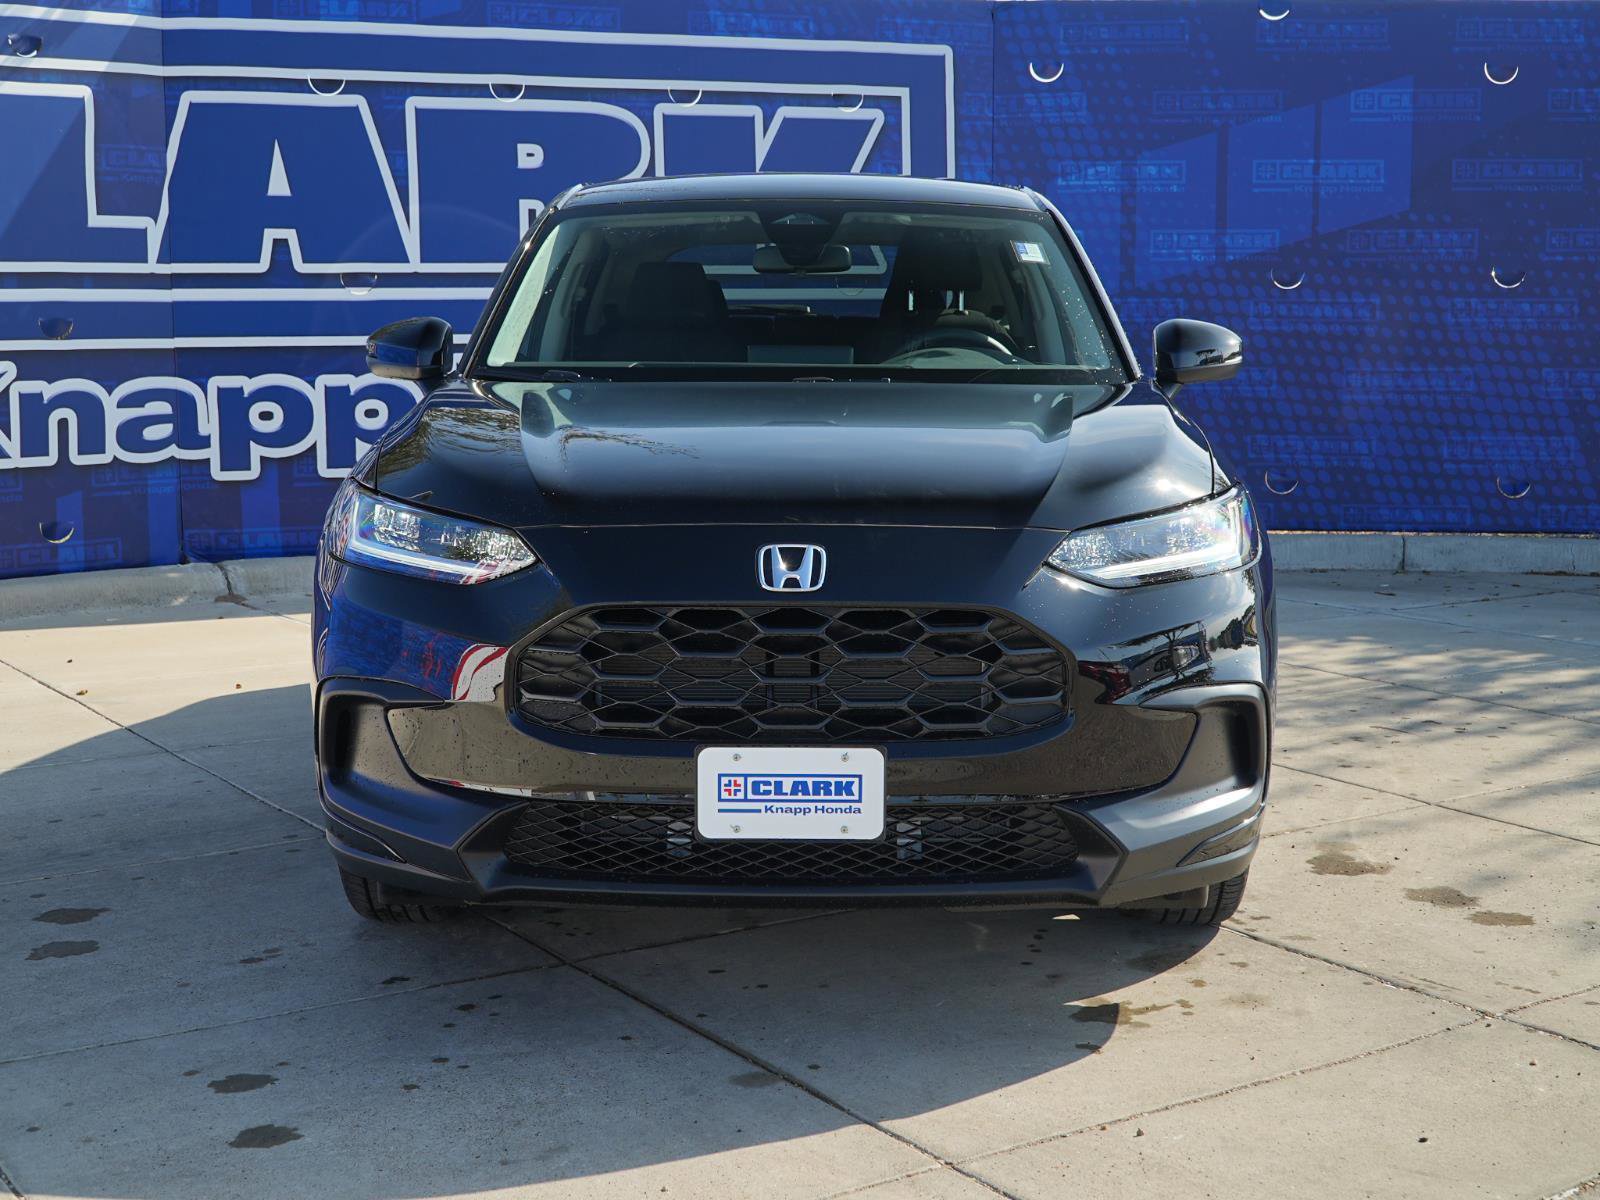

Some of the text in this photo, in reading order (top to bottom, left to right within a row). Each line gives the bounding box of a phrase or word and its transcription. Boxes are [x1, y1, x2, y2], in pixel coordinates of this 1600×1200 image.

[0, 360, 425, 482] napp
[751, 780, 856, 797] CLARK
[764, 804, 862, 816] Knapp Honda
